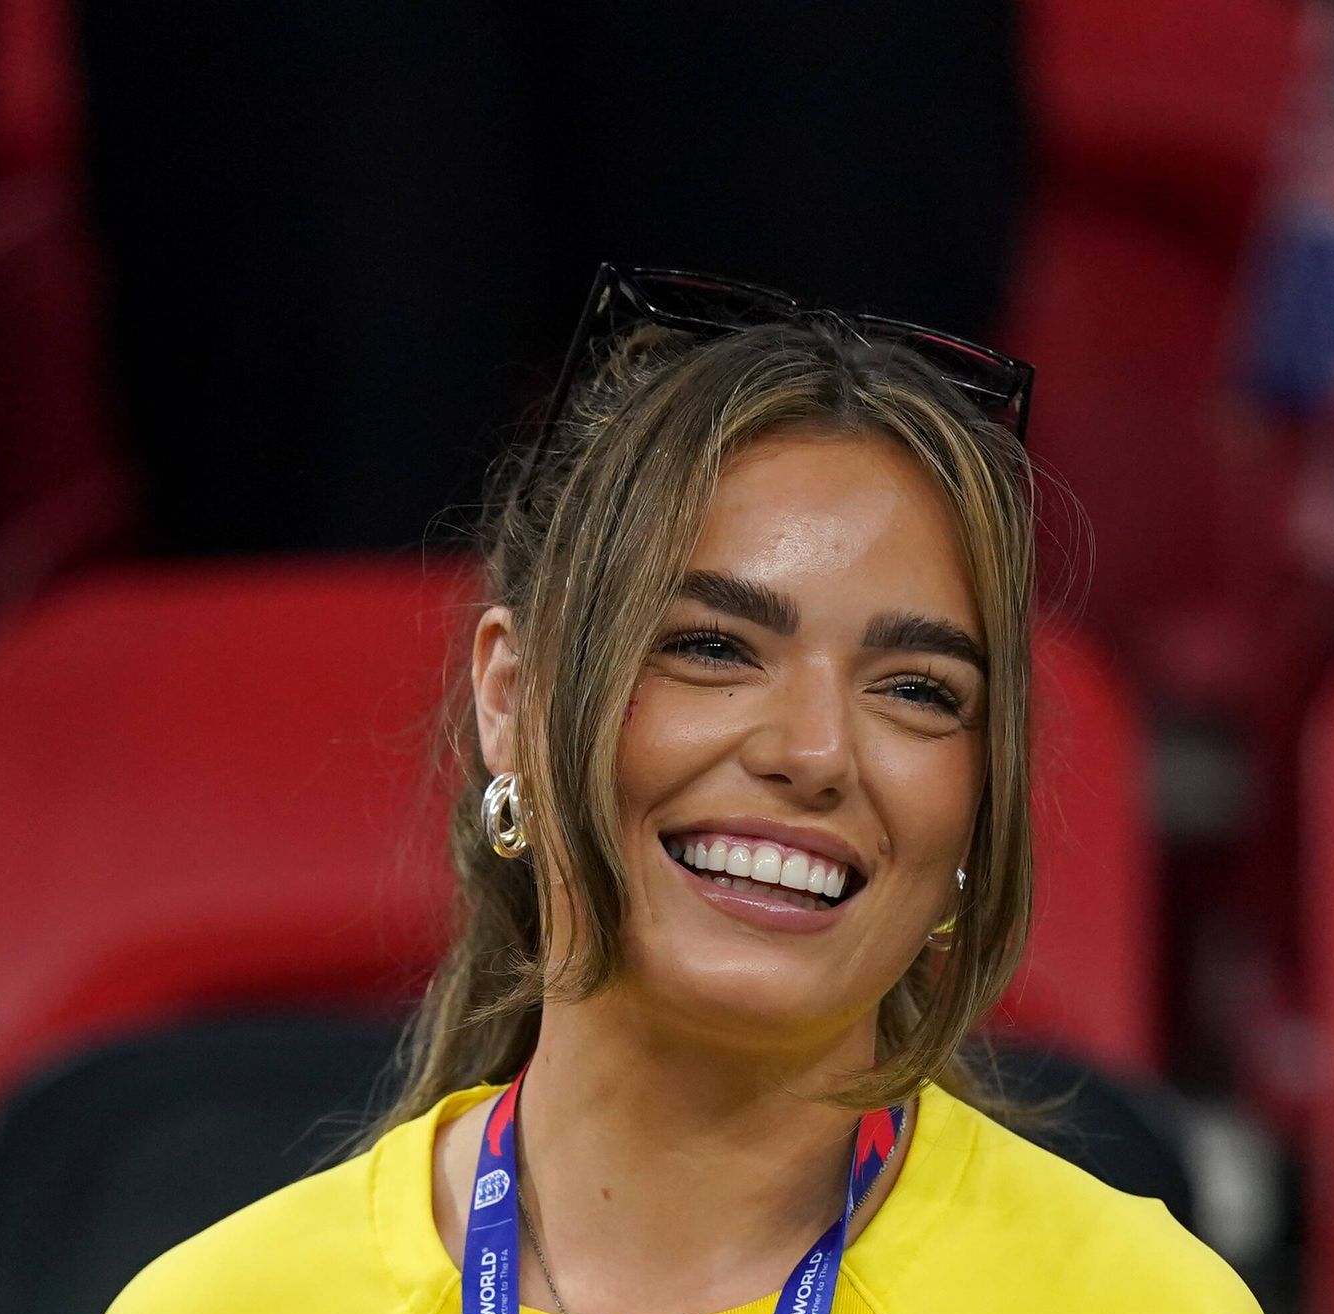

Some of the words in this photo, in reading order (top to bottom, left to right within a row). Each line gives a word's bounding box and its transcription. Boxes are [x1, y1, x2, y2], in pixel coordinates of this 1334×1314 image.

[500, 1261, 509, 1279] The
[819, 1263, 829, 1278] The
[817, 1281, 825, 1291] to
